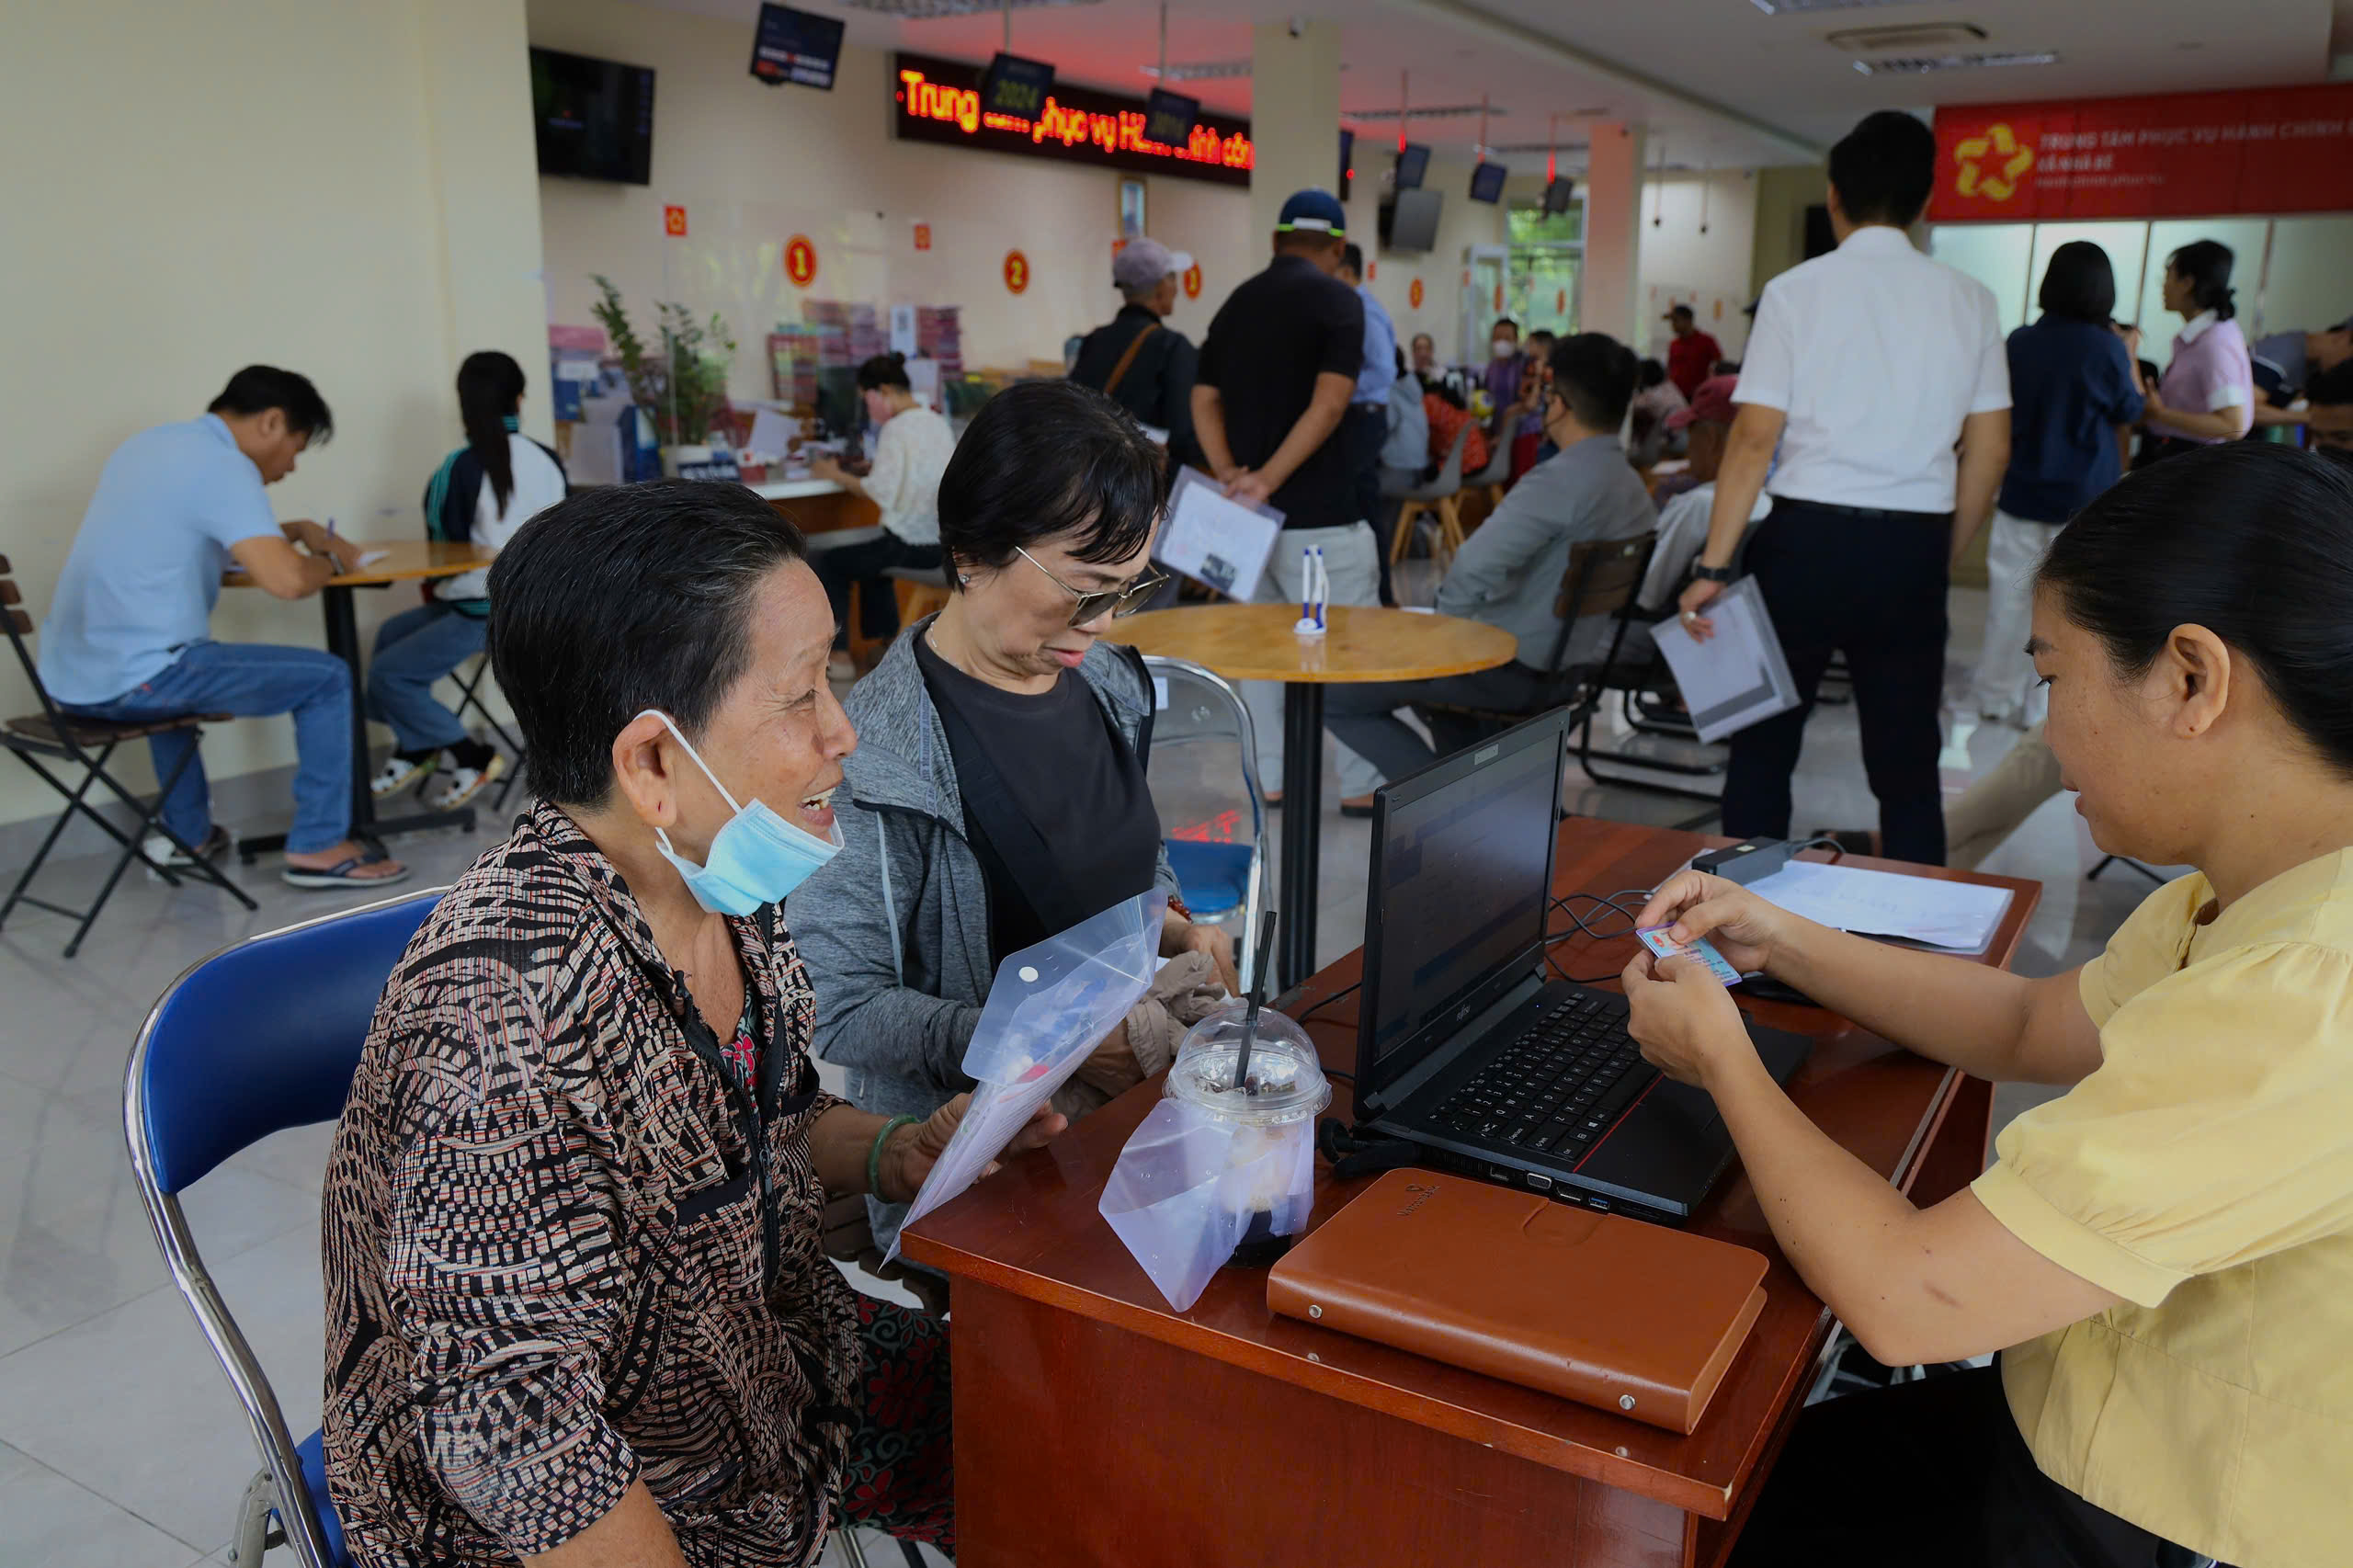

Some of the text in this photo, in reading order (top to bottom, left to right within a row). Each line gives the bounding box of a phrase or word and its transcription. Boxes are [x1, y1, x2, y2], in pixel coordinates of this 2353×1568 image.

[900, 70, 979, 132] Trung
[1088, 112, 1117, 153] vụ
[2039, 131, 2098, 150] TRUNG
[794, 248, 807, 276] 1
[1011, 260, 1022, 285] 2
